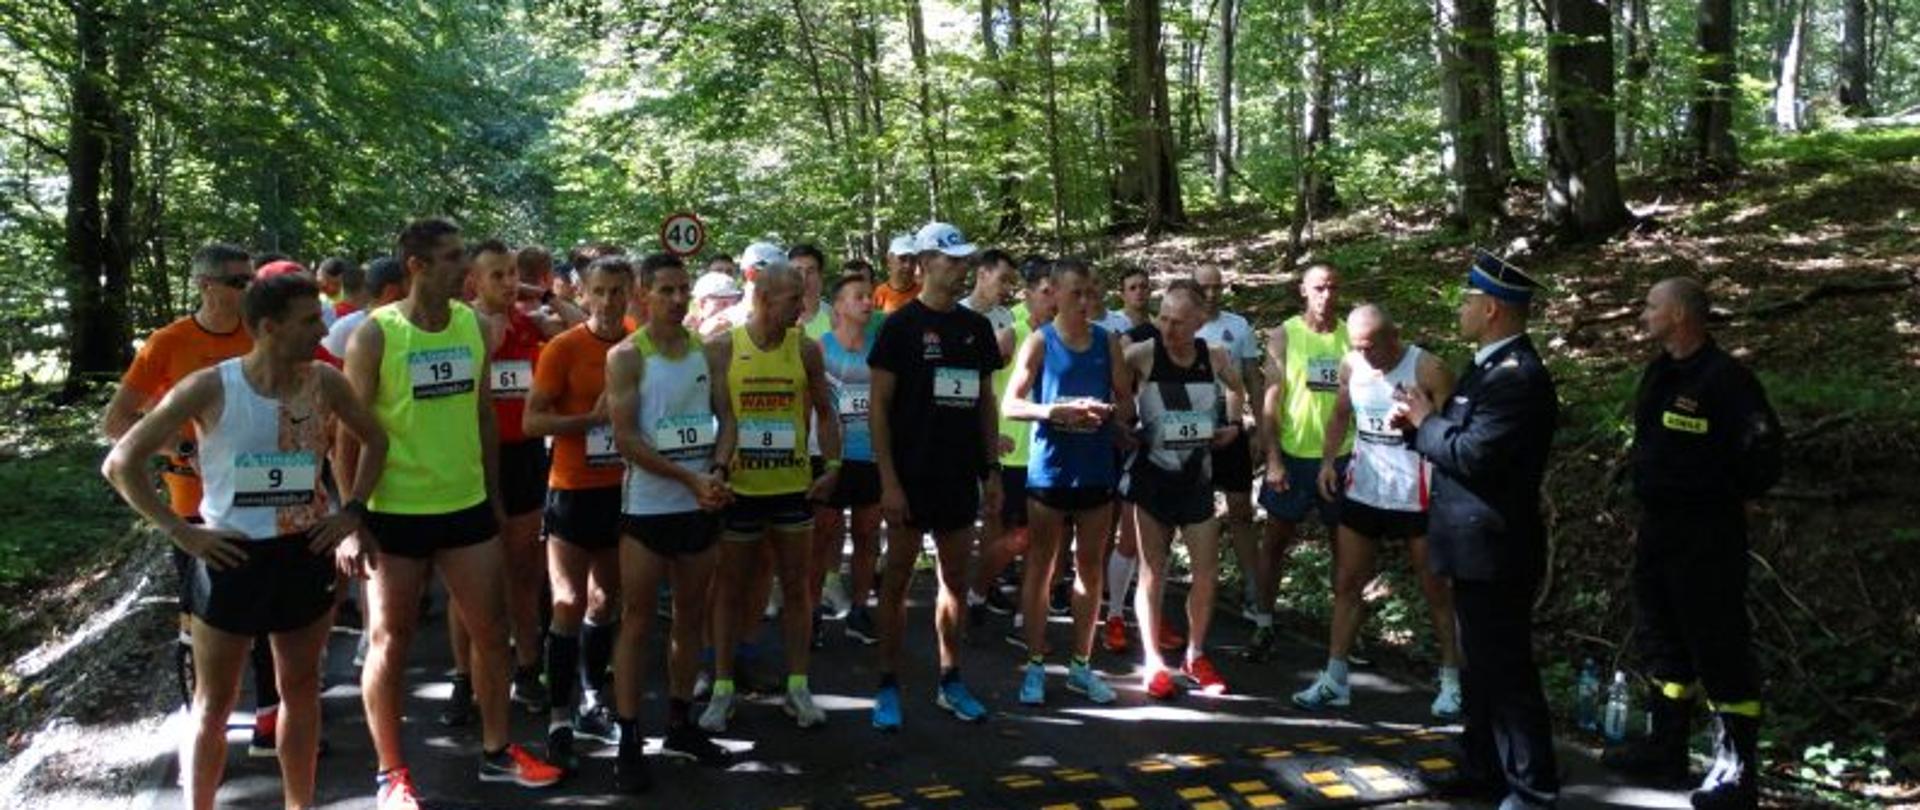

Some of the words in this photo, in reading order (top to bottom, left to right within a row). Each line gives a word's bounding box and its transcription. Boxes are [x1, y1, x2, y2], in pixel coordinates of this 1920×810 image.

[667, 224, 698, 246] 40
[429, 361, 453, 381] 19
[500, 371, 517, 387] 61
[1321, 369, 1338, 382] 58
[952, 379, 962, 395] 2
[1179, 424, 1198, 437] 45
[1368, 418, 1384, 431] 12
[677, 427, 698, 445] 10
[762, 431, 773, 446] 8
[268, 468, 283, 488] 9
